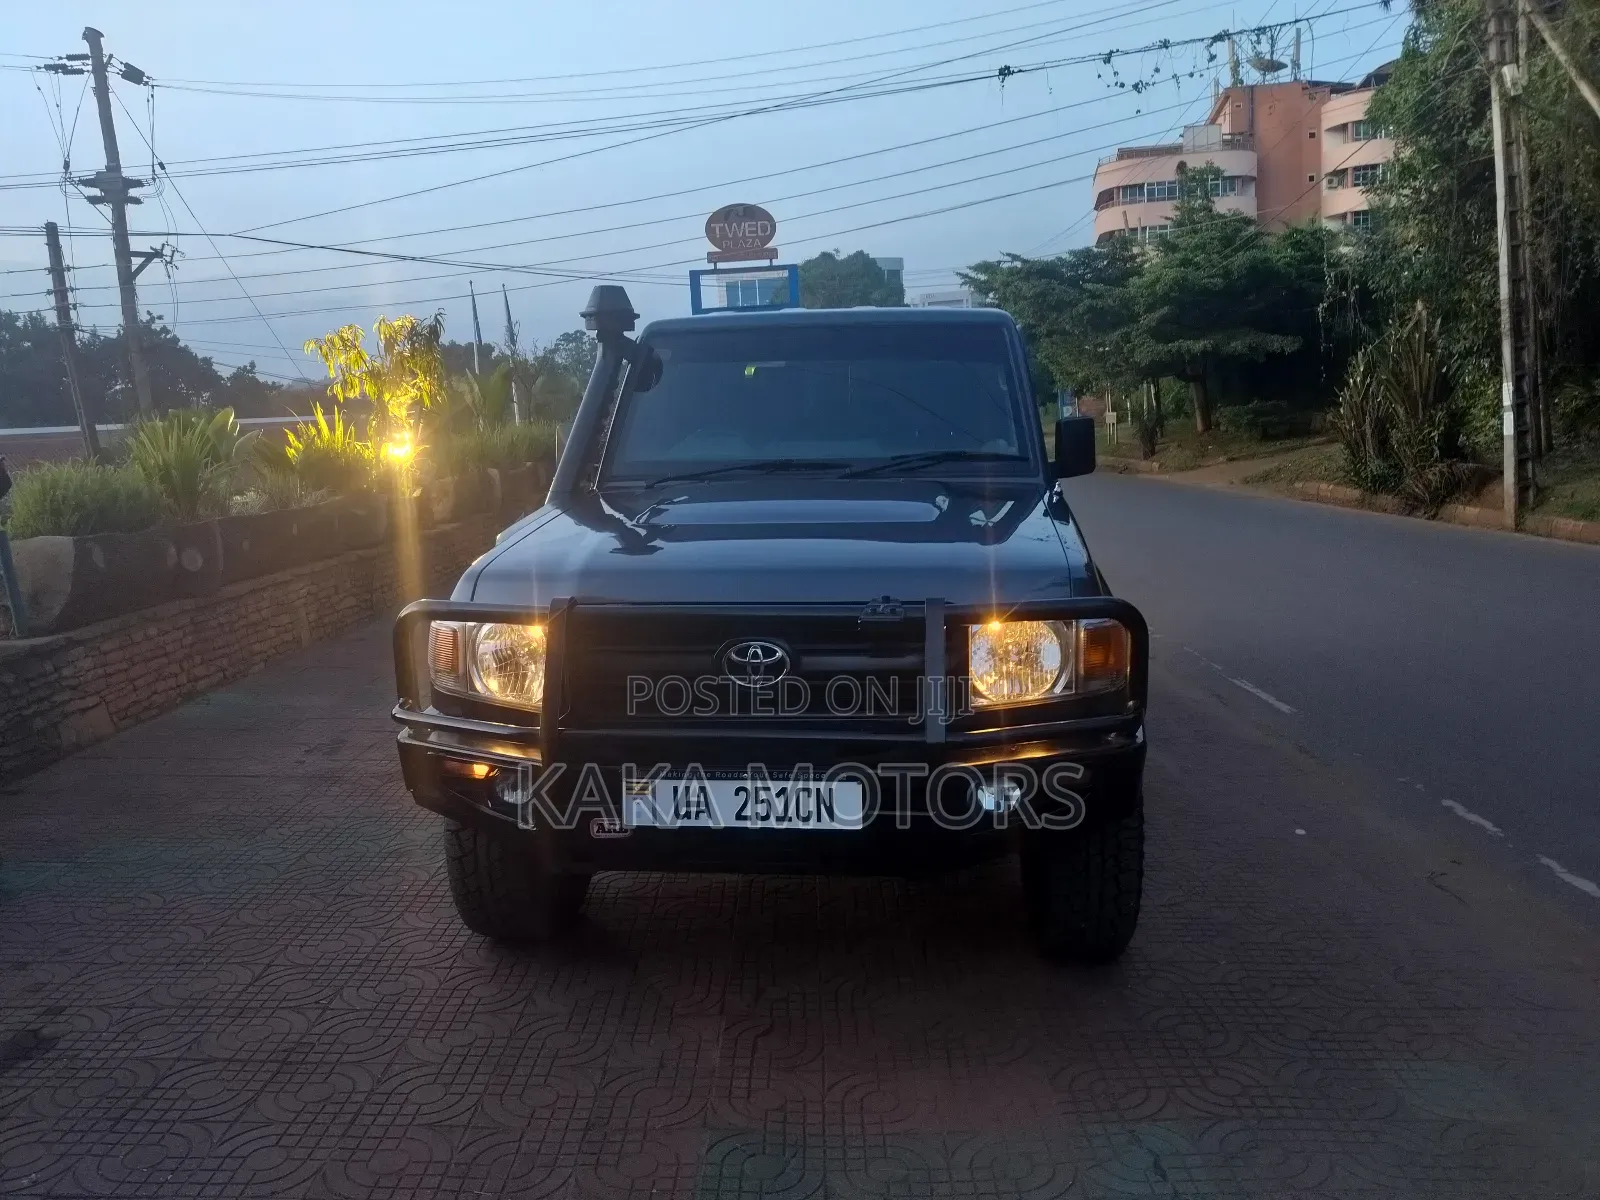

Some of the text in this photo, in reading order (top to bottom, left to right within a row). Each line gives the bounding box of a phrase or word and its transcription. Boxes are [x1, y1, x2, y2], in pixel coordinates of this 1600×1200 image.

[710, 220, 771, 238] TWED
[722, 239, 761, 249] PLAZA
[672, 785, 835, 823] UA 251CN
